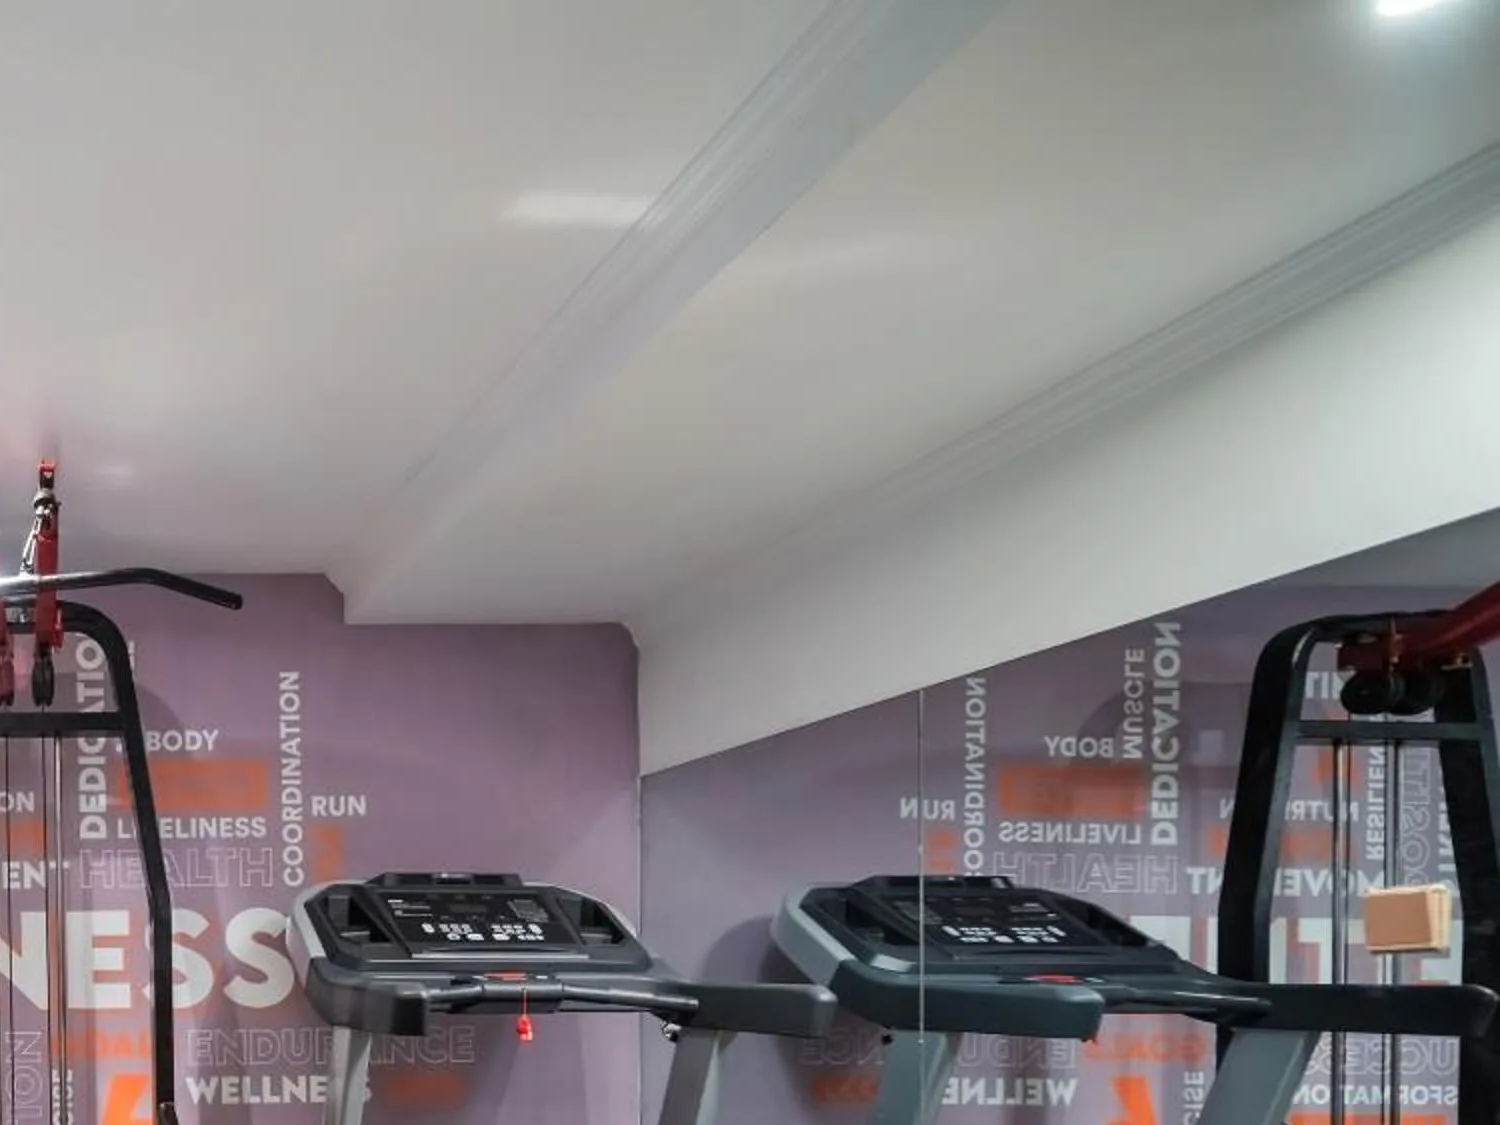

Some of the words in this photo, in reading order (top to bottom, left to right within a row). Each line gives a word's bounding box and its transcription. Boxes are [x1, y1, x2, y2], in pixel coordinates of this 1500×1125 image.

[76, 632, 107, 840] DEDICTIO
[148, 730, 219, 751] BODY
[279, 671, 304, 887] COORDINATION
[312, 796, 367, 817] RUN
[117, 815, 267, 840] LIELINESS
